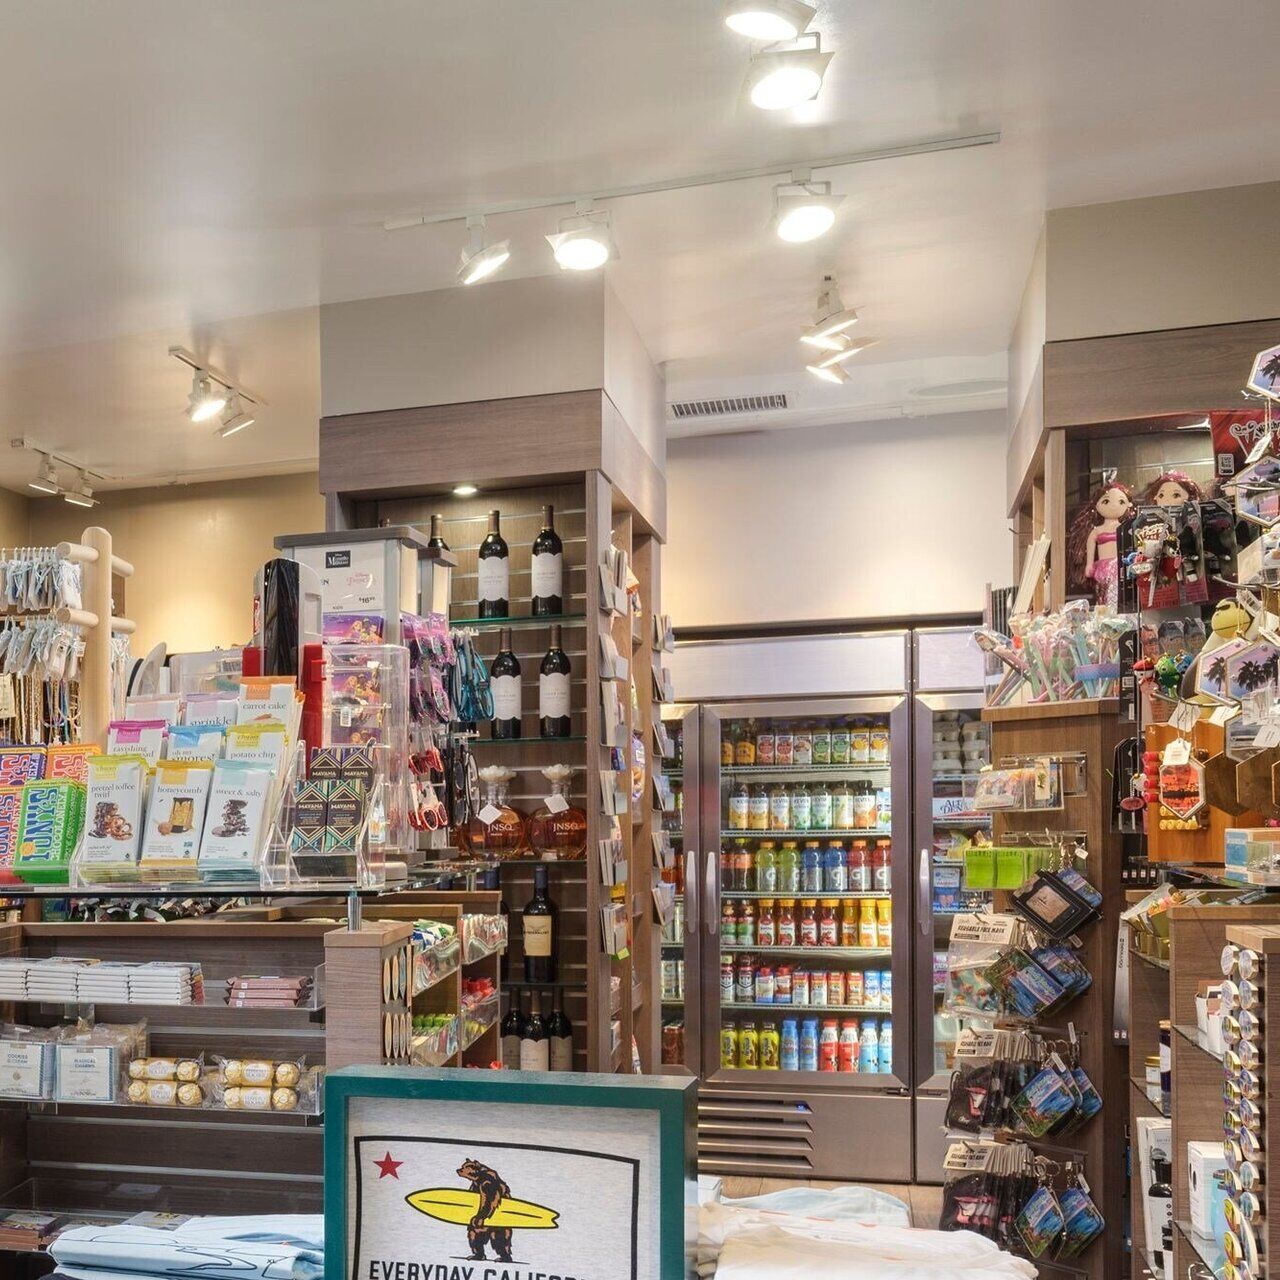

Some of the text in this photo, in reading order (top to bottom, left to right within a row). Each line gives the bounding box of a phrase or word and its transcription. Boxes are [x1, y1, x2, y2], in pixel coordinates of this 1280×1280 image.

[230, 751, 276, 760] potato chip
[91, 784, 114, 792] pretzel
[157, 786, 202, 795] honeycomb
